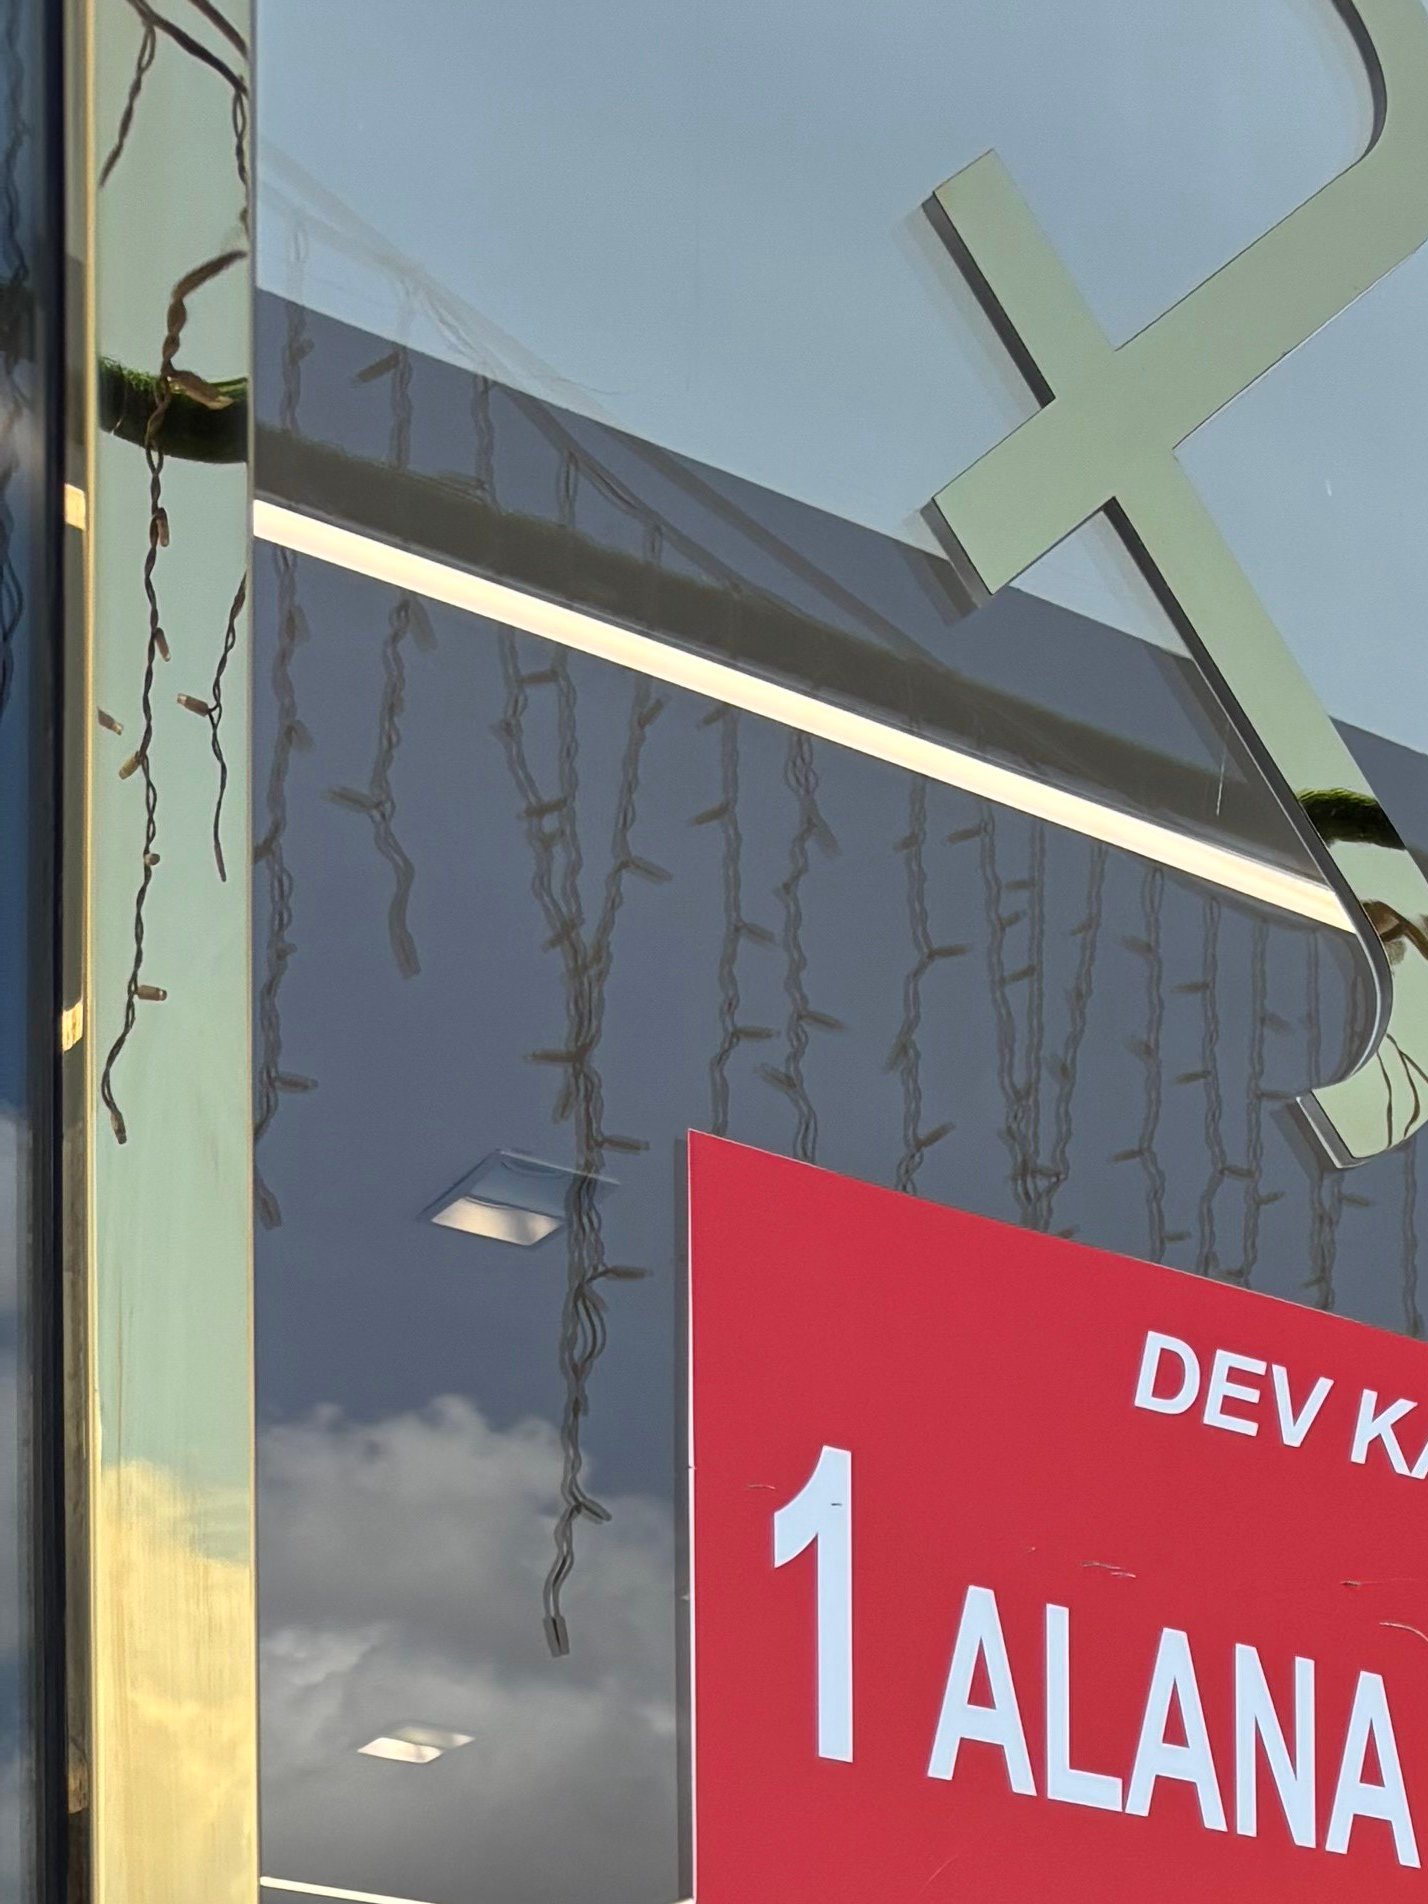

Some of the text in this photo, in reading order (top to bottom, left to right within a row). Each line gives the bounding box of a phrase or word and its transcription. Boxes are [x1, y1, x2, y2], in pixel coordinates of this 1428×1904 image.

[1134, 1330, 1334, 1448] DEV
[773, 1444, 854, 1763] 1
[927, 1584, 1422, 1869] ALANA
